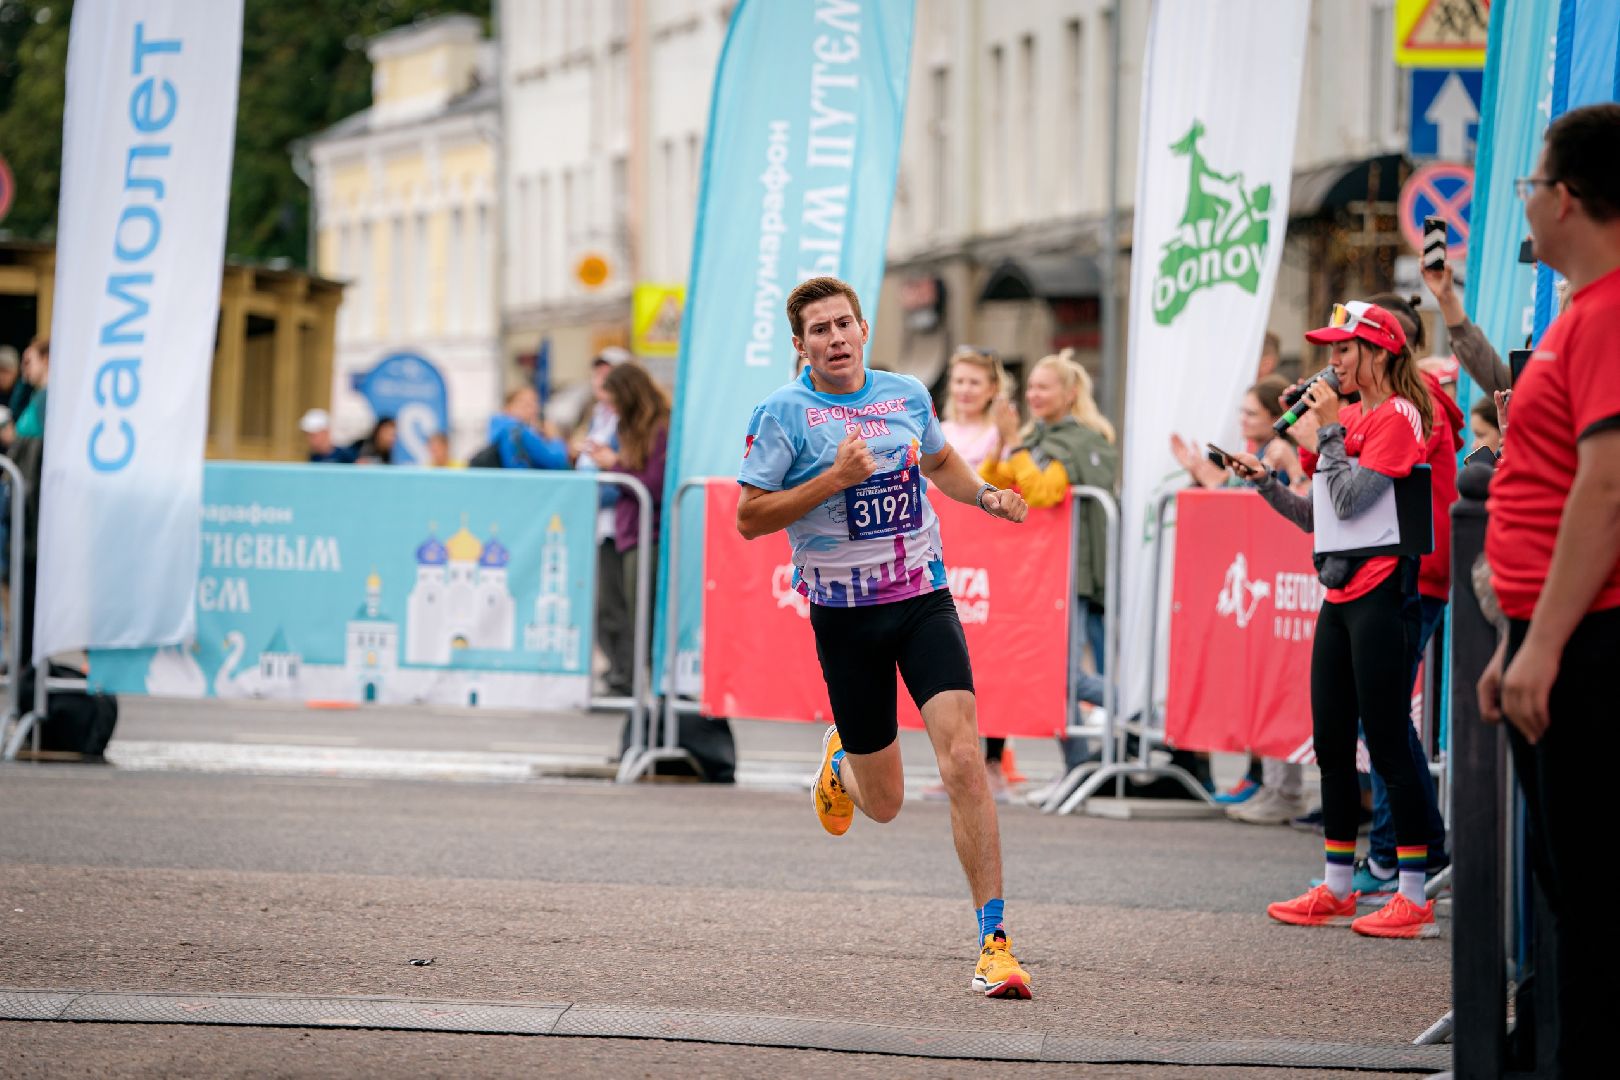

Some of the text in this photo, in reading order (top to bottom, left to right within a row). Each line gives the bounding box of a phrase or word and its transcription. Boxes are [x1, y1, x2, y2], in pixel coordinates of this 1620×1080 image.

[86, 22, 184, 476] самолет
[745, 120, 791, 367] Полумарафон
[854, 492, 910, 528] 3192
